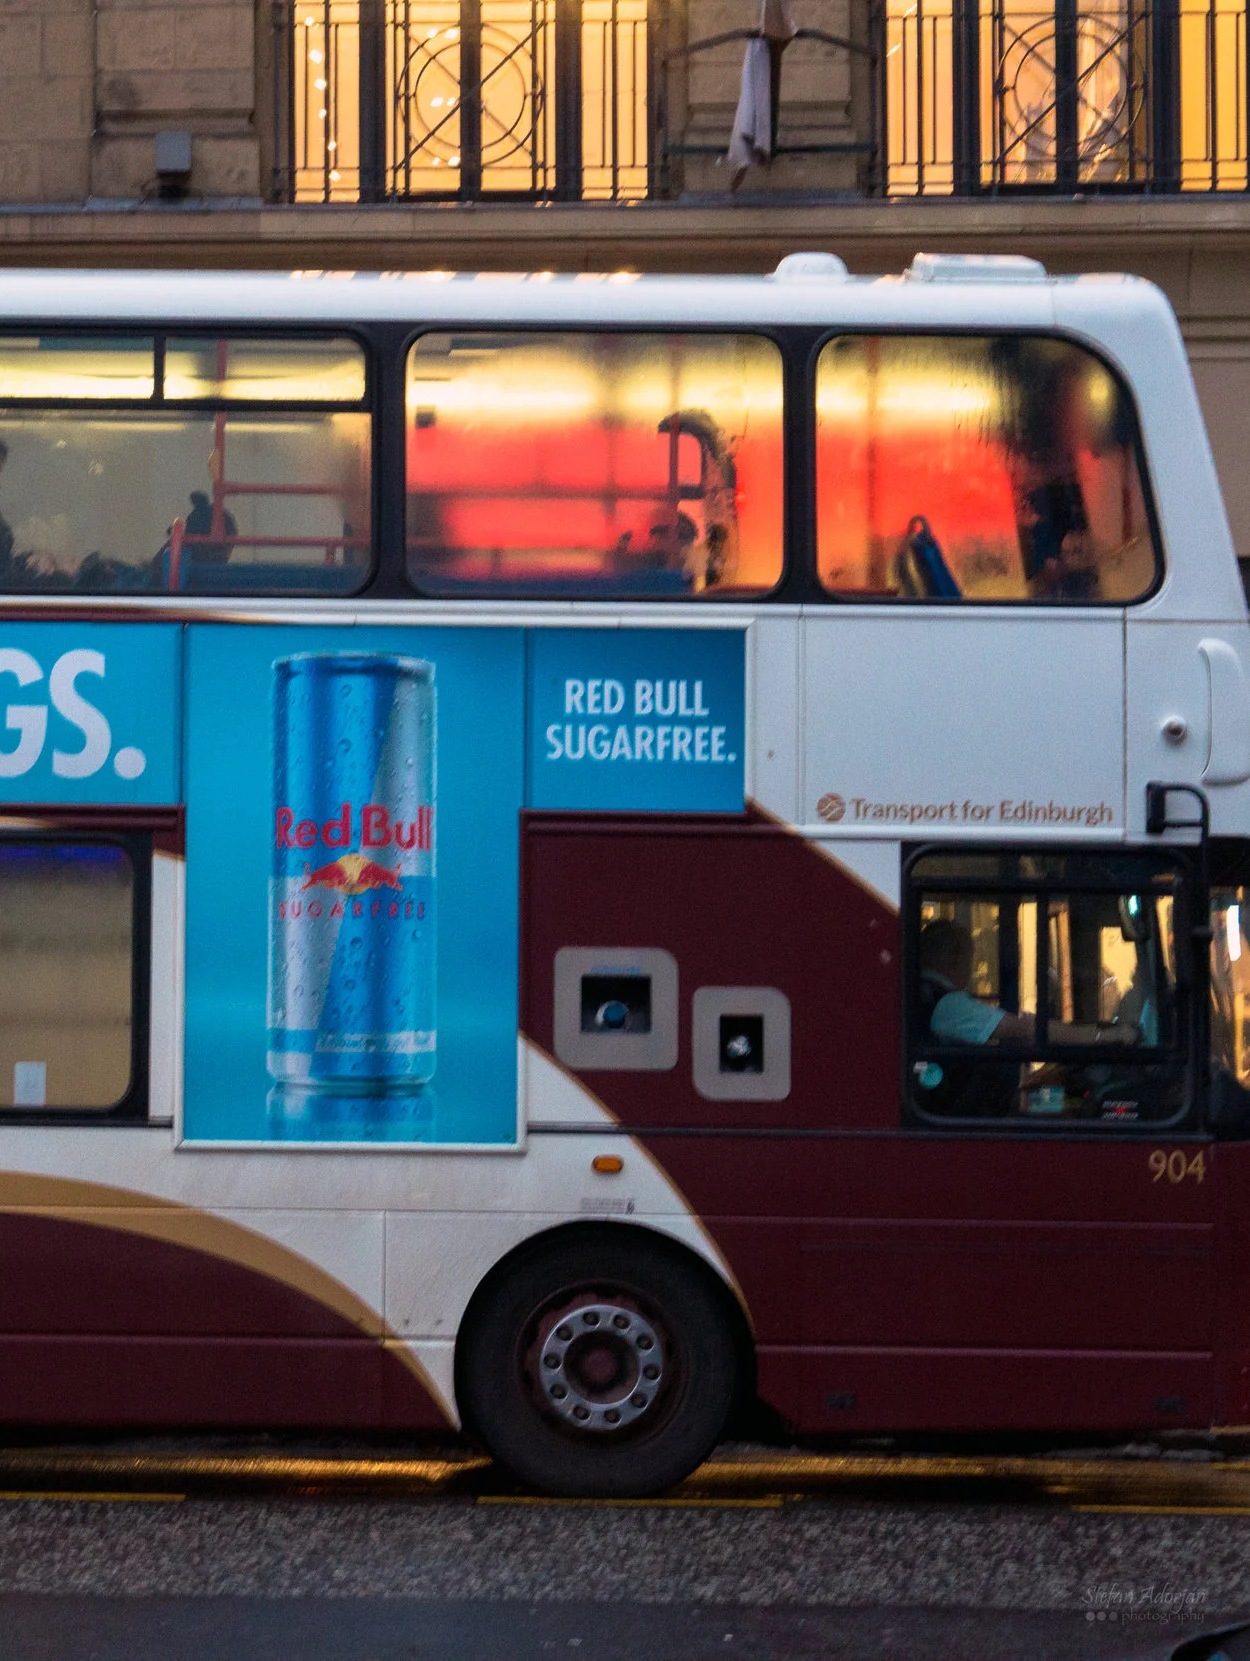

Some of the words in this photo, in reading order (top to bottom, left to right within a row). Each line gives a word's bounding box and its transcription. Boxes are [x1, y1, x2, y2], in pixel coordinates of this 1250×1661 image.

[564, 679, 625, 716] RED
[634, 679, 710, 717] BULL
[545, 724, 738, 763] SUGARFREE.
[275, 802, 352, 850] Red
[361, 804, 433, 852] Bull
[852, 798, 956, 825] Transport
[959, 799, 994, 822] for
[999, 801, 1114, 826] Edinburgh
[1148, 1149, 1207, 1185] 904
